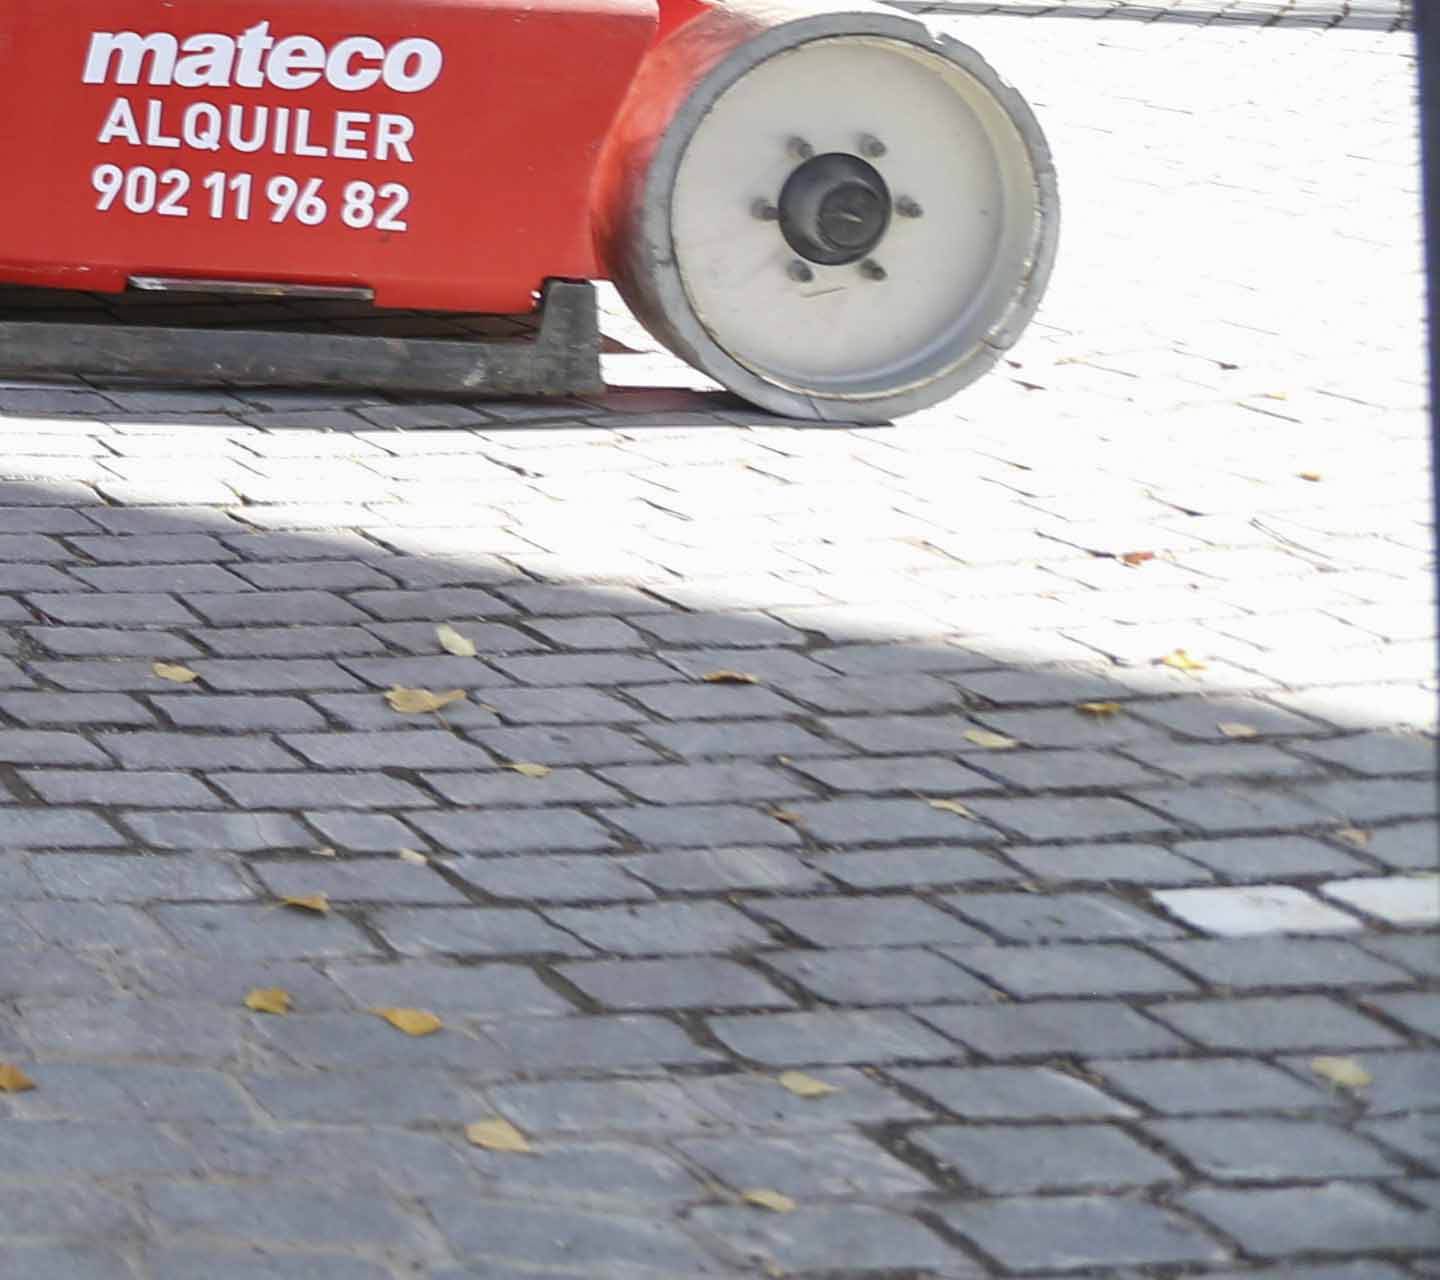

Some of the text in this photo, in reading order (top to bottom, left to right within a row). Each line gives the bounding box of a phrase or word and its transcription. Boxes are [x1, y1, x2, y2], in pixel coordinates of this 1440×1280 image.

[82, 20, 443, 92] mateco
[97, 98, 415, 162] ALQUILER
[91, 164, 411, 231] 902 11 96 82
